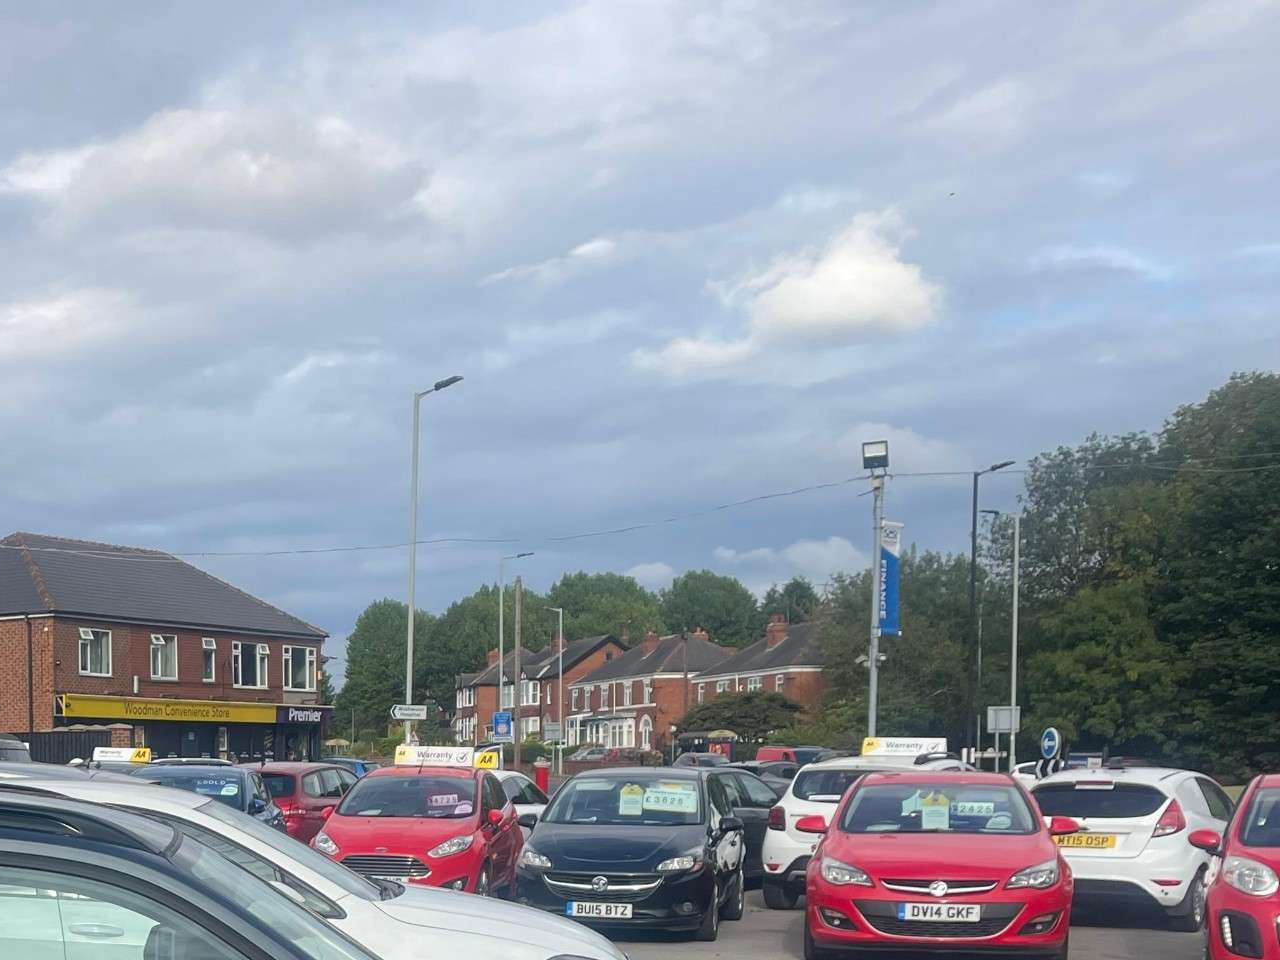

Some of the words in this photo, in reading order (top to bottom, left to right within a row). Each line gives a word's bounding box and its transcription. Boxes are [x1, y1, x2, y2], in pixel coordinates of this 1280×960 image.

[124, 702, 163, 716] Woodman
[164, 704, 210, 718] Convenience
[212, 705, 230, 719] Store
[289, 707, 322, 722] Premier
[886, 741, 923, 750] Warranty
[135, 750, 146, 758] AA
[417, 750, 453, 760] Warranty
[480, 755, 493, 764] AA
[576, 903, 602, 915] BU15
[605, 905, 628, 916] BTZ
[911, 905, 942, 918] DV14
[947, 906, 975, 919] GKF
